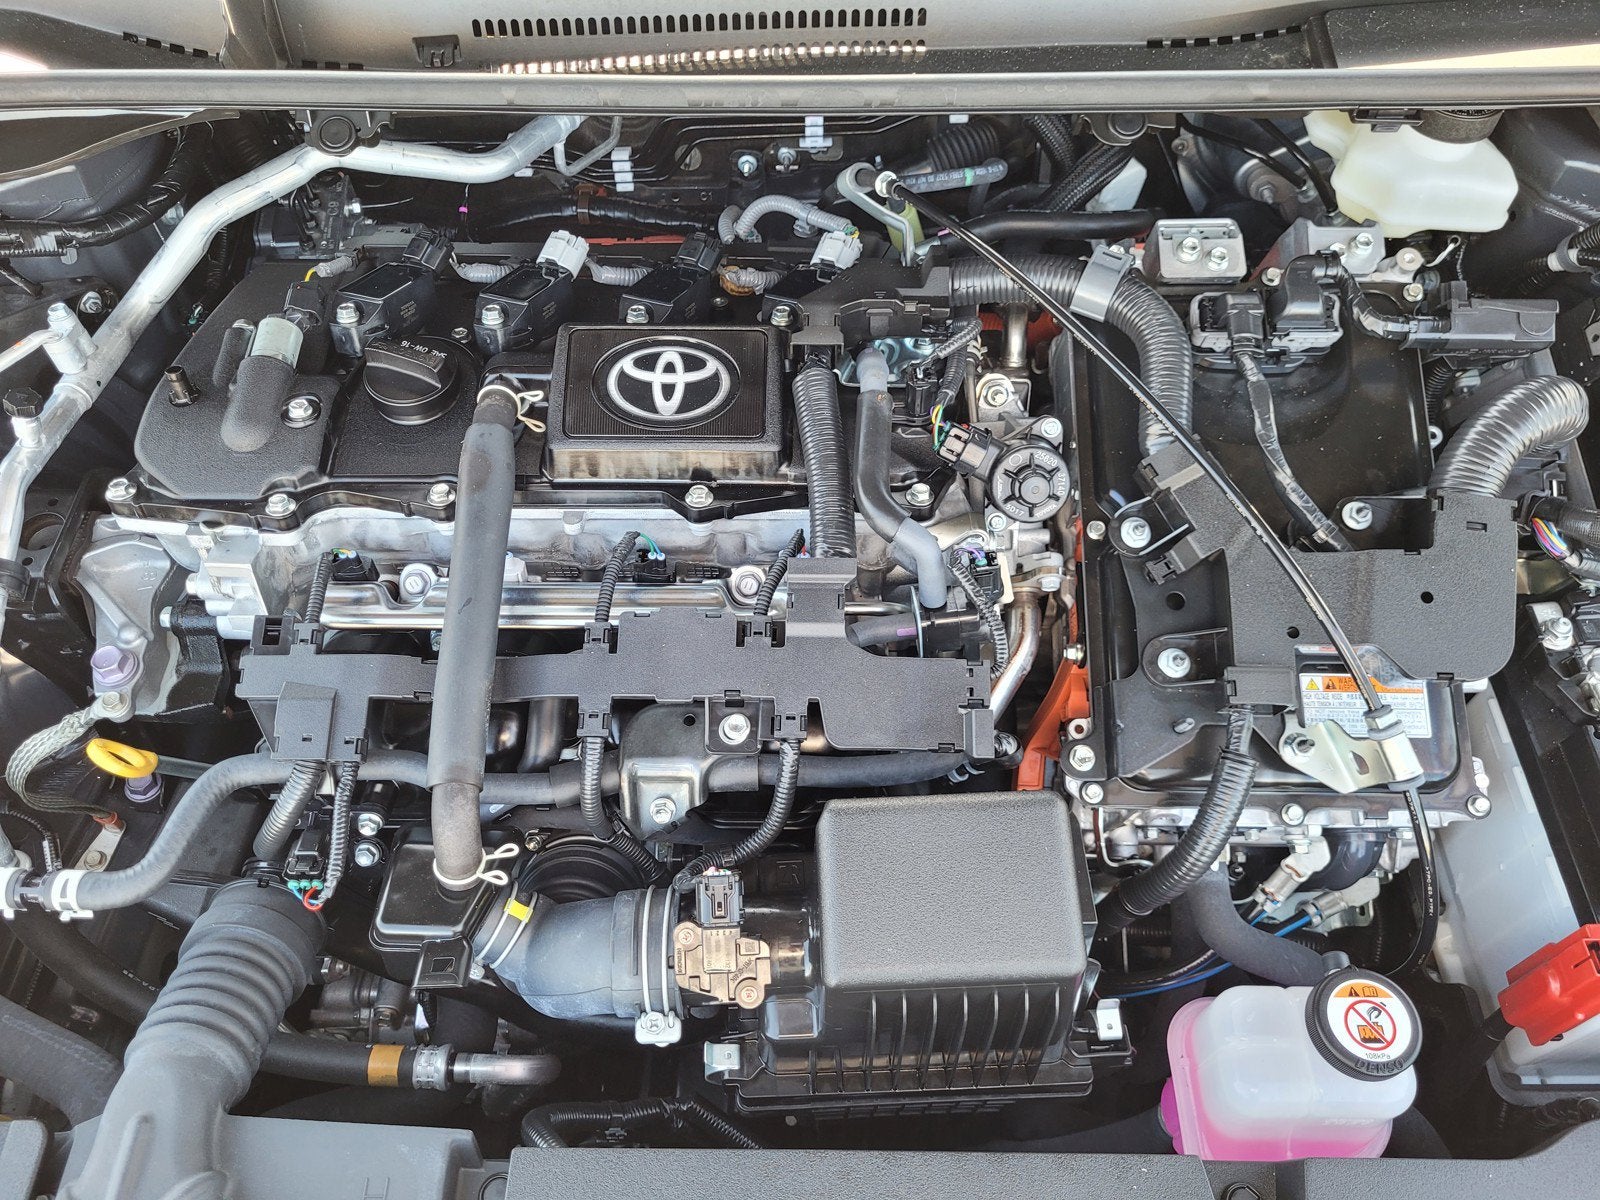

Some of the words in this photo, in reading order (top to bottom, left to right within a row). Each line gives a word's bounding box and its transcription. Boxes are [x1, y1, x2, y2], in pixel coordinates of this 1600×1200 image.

[430, 349, 448, 359] SAE
[1034, 449, 1058, 467] 25620
[1354, 1057, 1405, 1074] DENSO
